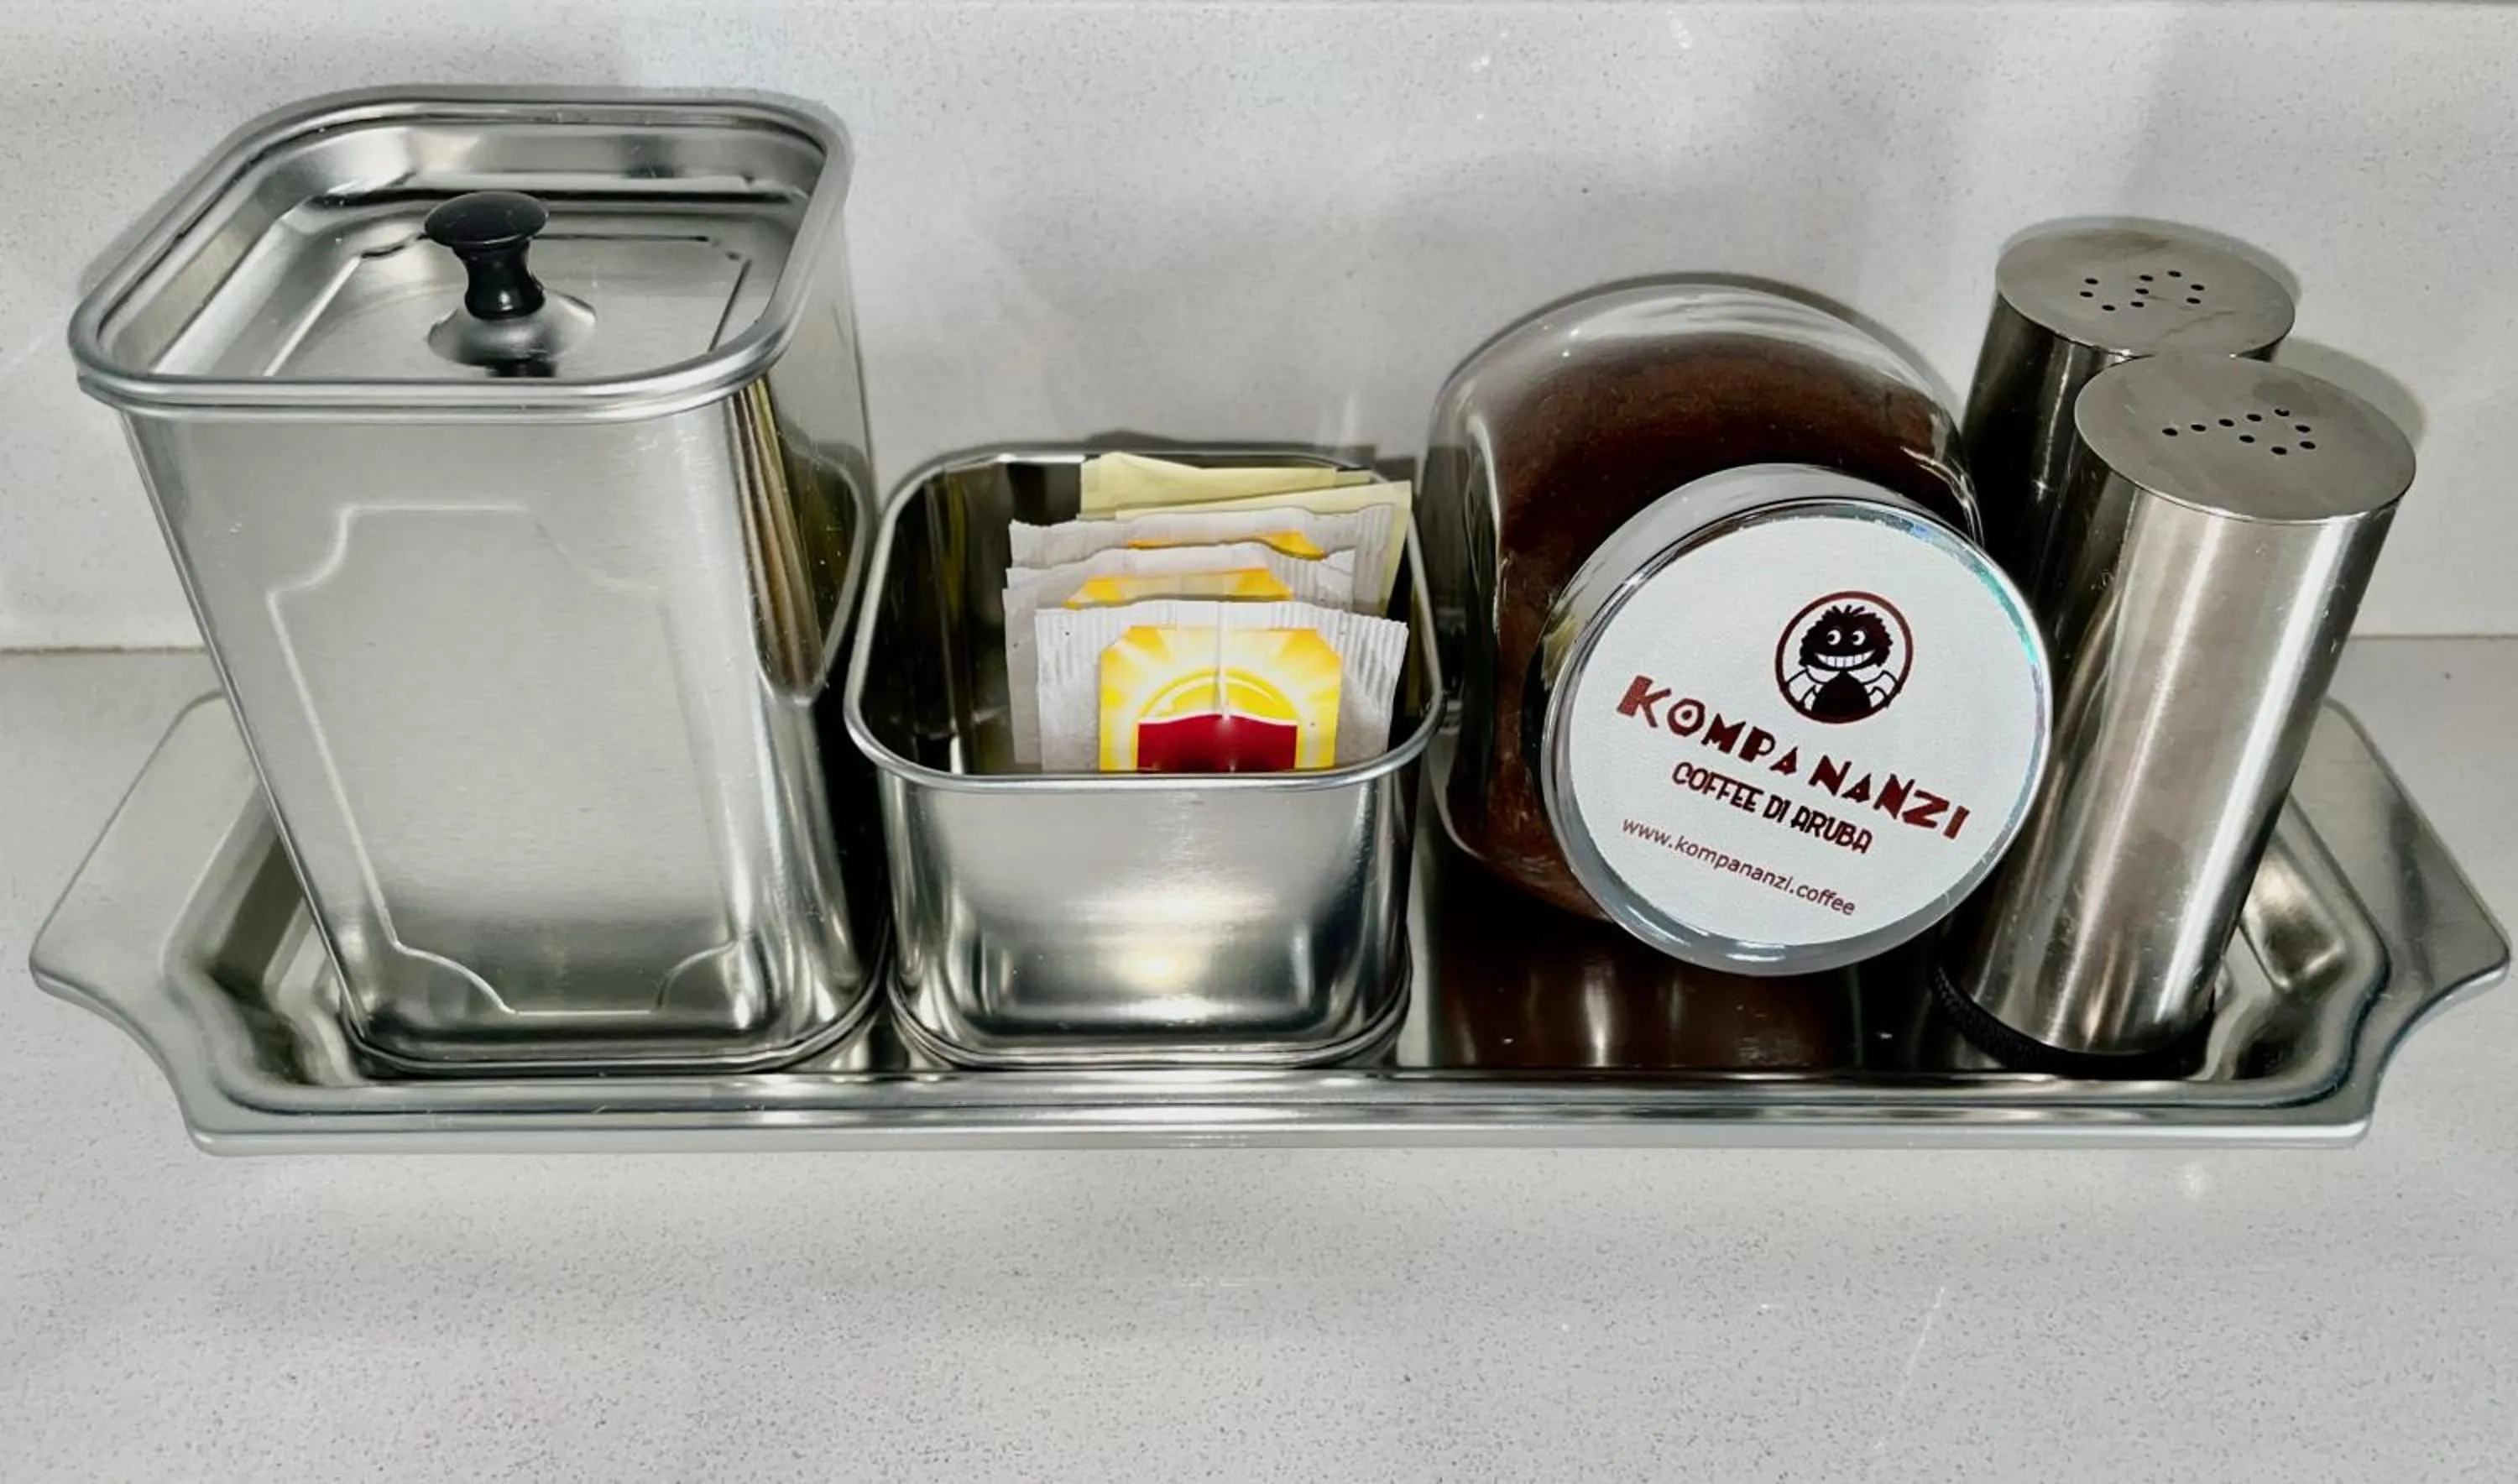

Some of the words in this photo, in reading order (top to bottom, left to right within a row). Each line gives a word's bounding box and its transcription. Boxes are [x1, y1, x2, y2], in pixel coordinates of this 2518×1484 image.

[1671, 761, 1765, 813] COFFEE
[1762, 793, 1792, 824] DI
[1789, 805, 1873, 855] ARUBA
[1622, 818, 1856, 916] www.kompananzi.coffee
